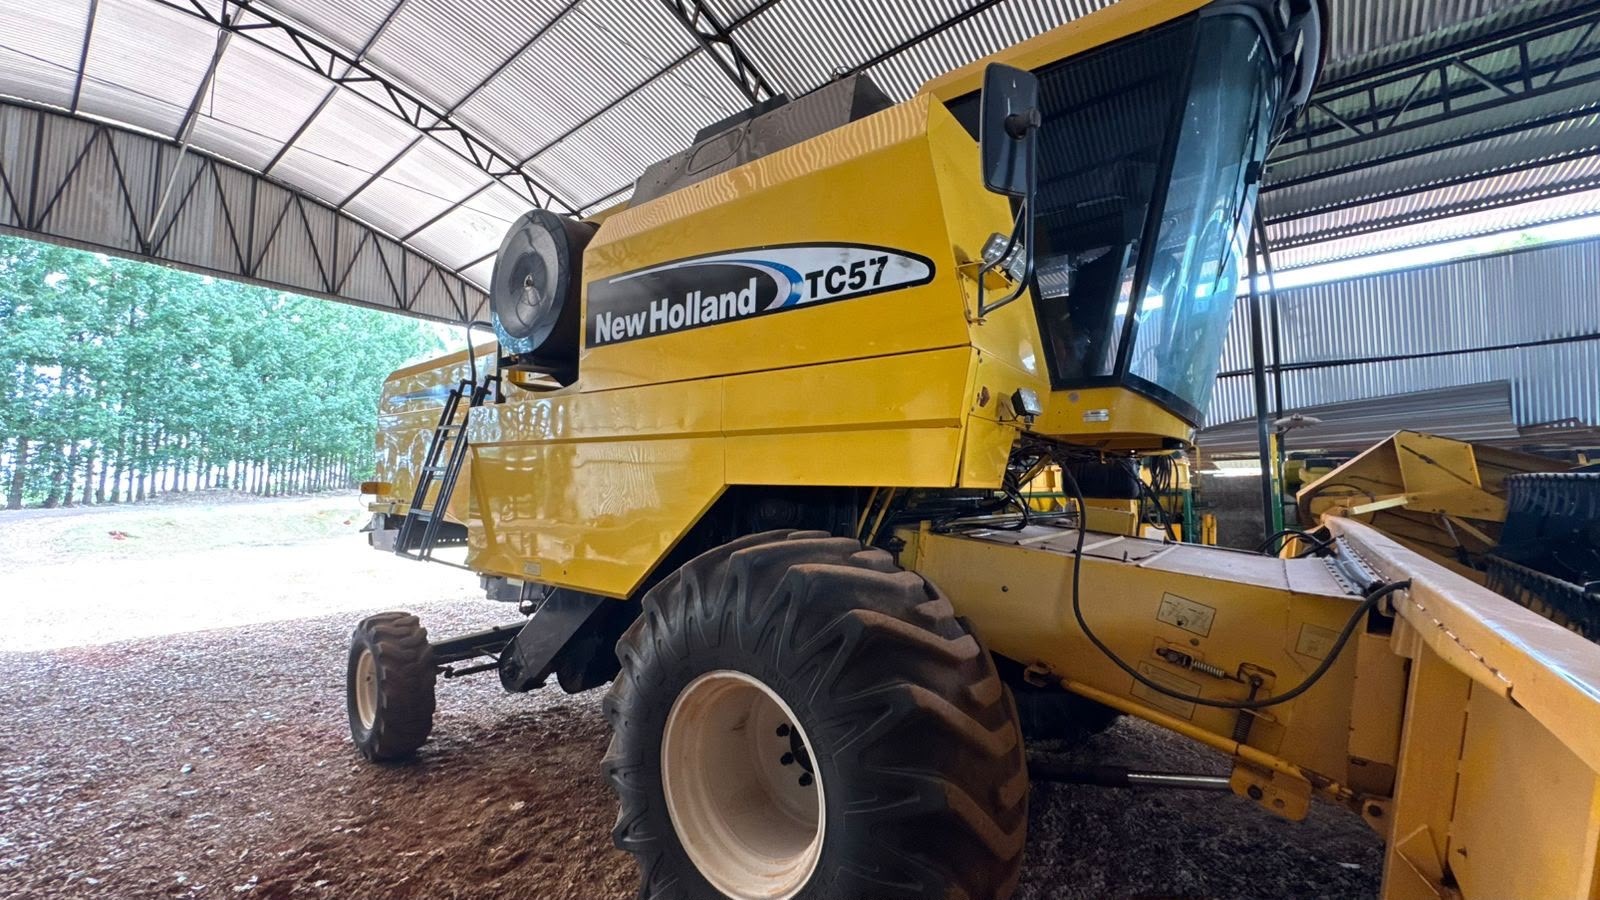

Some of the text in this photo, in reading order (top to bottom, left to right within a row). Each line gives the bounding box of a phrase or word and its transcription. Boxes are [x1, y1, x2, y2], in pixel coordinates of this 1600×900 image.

[594, 255, 889, 343] New Holland TC57
